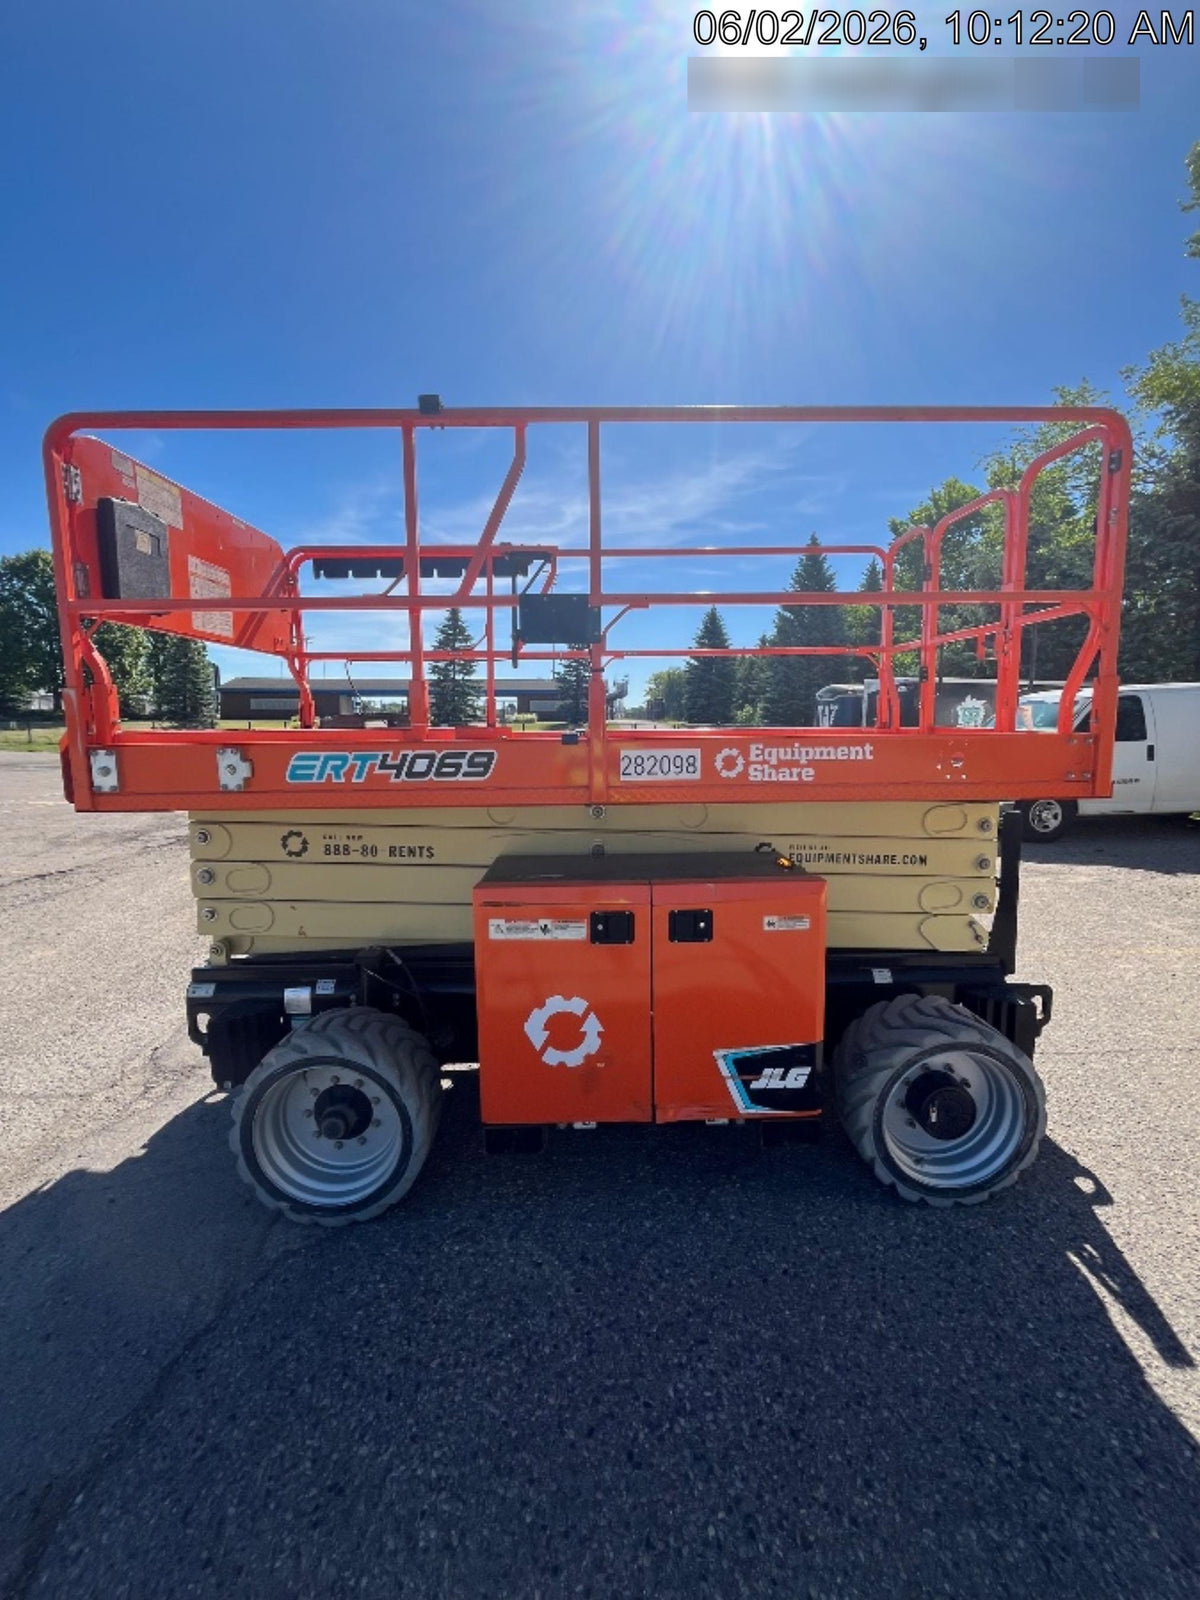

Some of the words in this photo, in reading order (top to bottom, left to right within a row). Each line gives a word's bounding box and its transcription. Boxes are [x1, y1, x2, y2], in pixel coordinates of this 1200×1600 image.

[748, 743, 874, 763] Equipment
[286, 750, 497, 783] ERT4069
[621, 754, 698, 776] 282098
[748, 765, 816, 782] Share
[388, 845, 435, 859] RENTS
[749, 1066, 812, 1089] JLG
